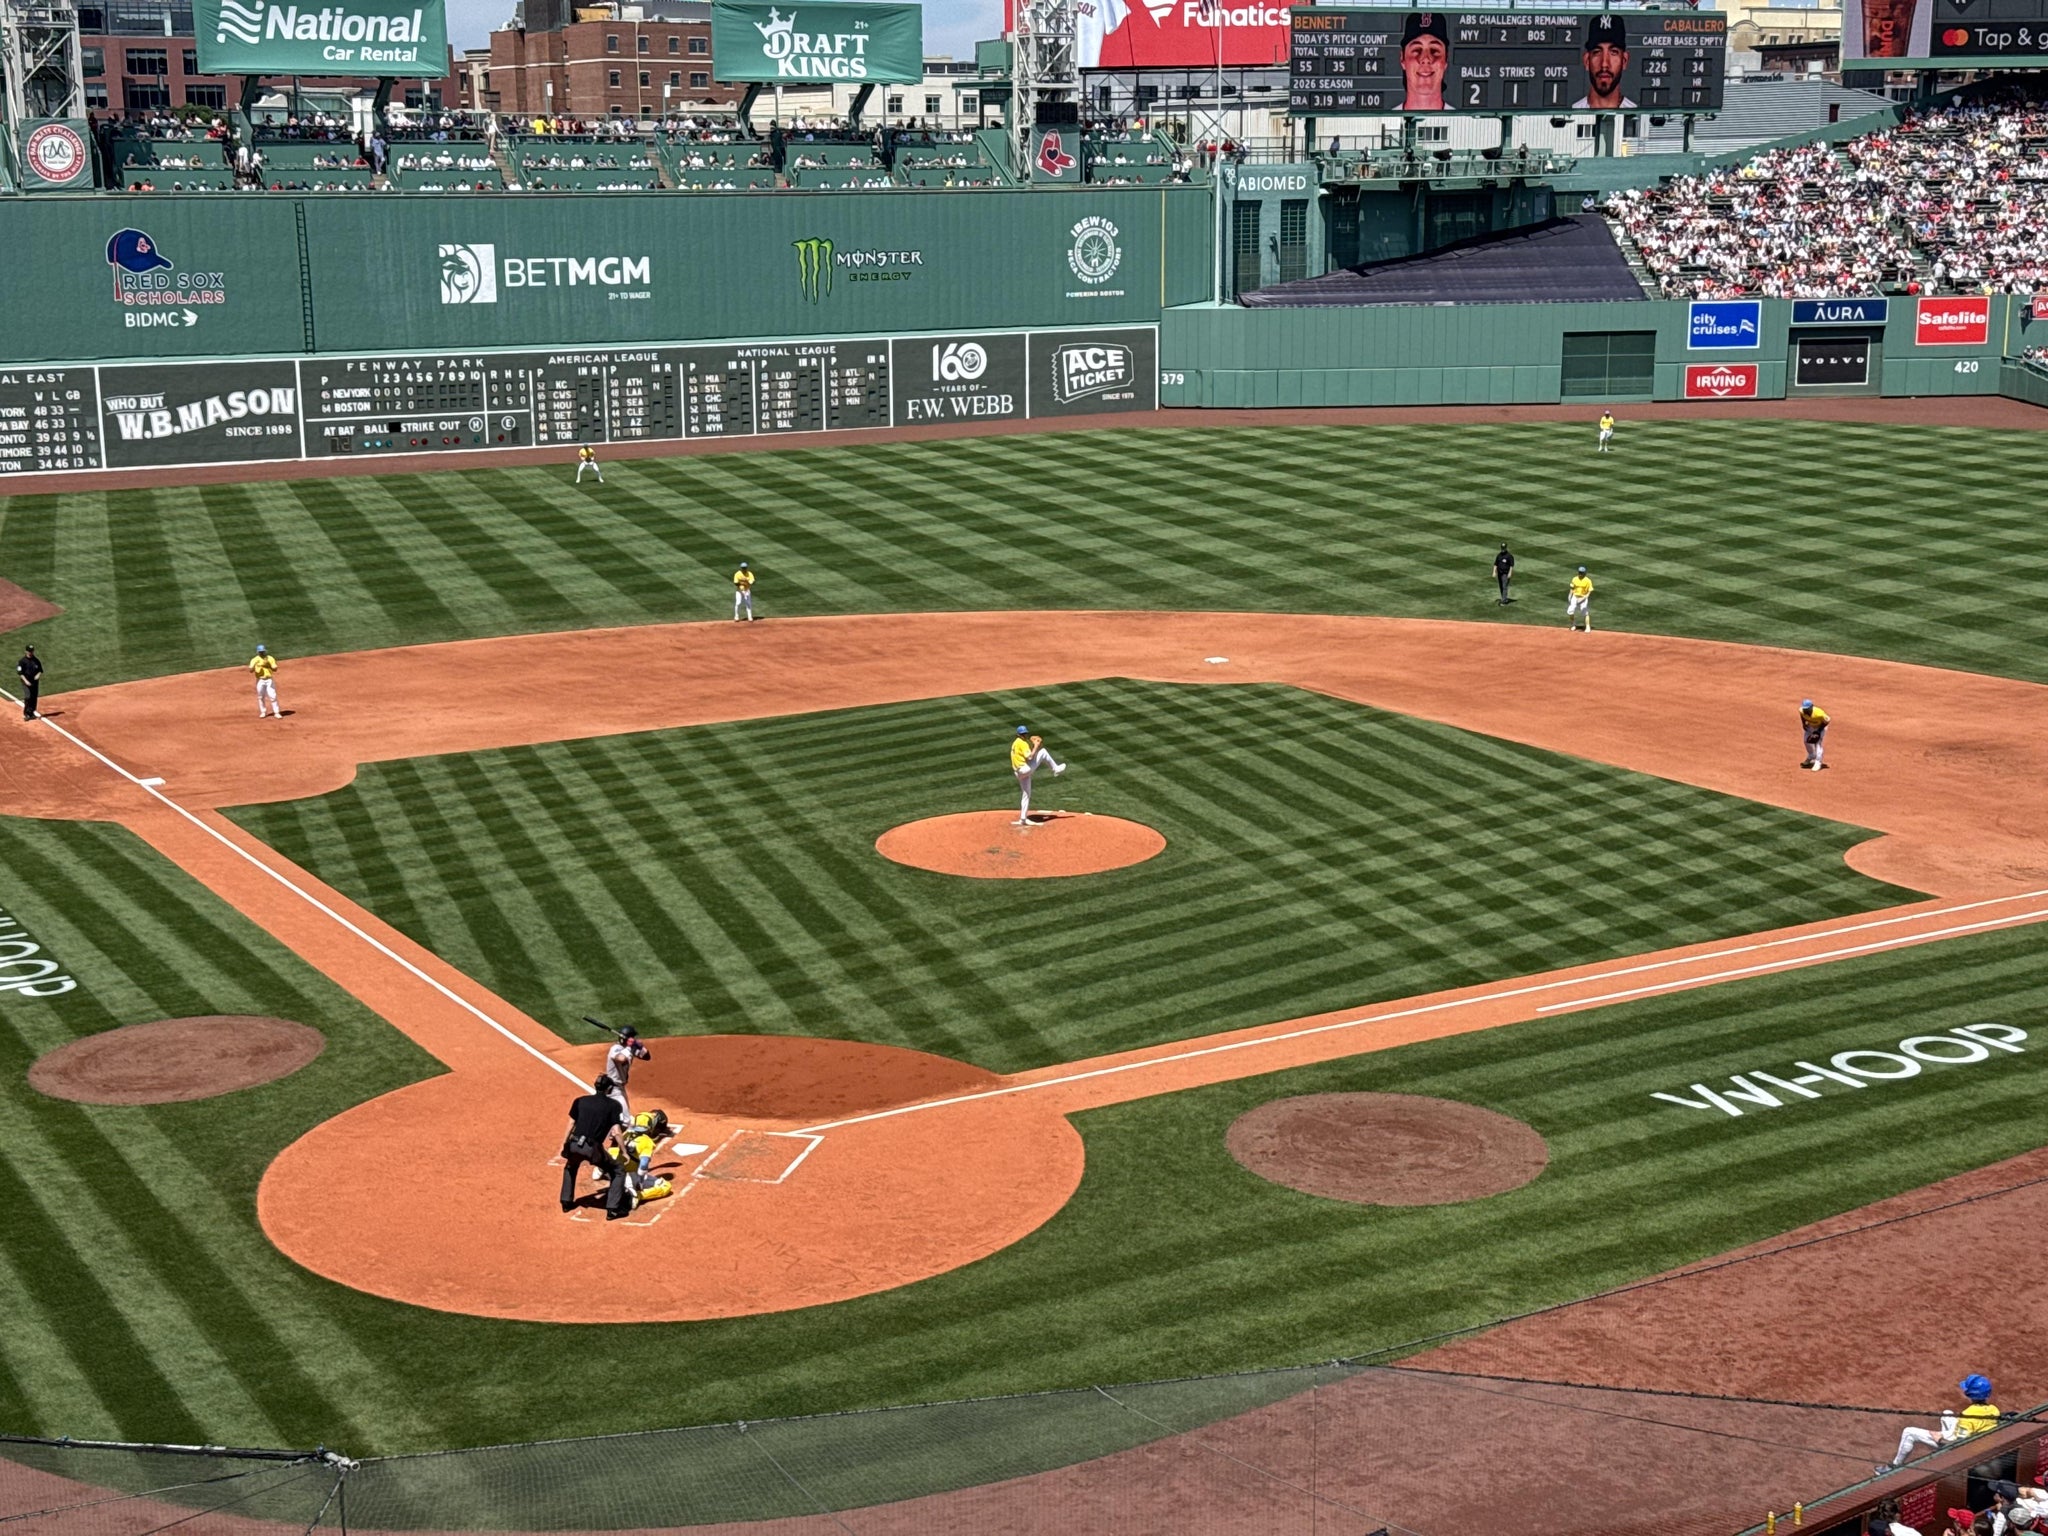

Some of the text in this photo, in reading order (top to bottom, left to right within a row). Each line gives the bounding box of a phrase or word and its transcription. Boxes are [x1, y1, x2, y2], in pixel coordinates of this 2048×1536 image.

[1077, 1, 1098, 18] SOX
[1183, 2, 1291, 28] Fanatics
[265, 5, 423, 43] National
[854, 20, 869, 30] 21+
[1294, 16, 1347, 29] BENNETT
[1459, 15, 1578, 26] ABS CHALLENGES REMAINING
[1663, 20, 1724, 32] CABALLERO
[1294, 34, 1388, 45] TODAY'S PITCH COUNT
[1460, 30, 1572, 42] NYY 2 BOS 2
[1642, 36, 1724, 46] CAREER BASES EMPTY
[1974, 28, 2012, 50] Tap
[2017, 27, 2032, 46] &
[763, 31, 870, 59] DRAFT
[323, 46, 418, 62] Car Rental
[1294, 47, 1379, 57] TOTAL STRIKES PCT
[1650, 49, 1664, 57] AVG
[778, 54, 868, 78] KINGS
[1299, 61, 1378, 72] 55 35 64
[1645, 62, 1705, 73] .226 34
[1461, 67, 1568, 78] BALLS STRIKES OUTS
[1293, 79, 1354, 88] 2026 SEASON
[1692, 78, 1702, 87] HR
[1470, 83, 1558, 104] 2 1 1
[1653, 91, 1702, 103] 1 17
[1291, 95, 1380, 106] ERA 3.19 WHIP 1.00
[1238, 176, 1307, 191] ABIOMED
[836, 248, 924, 268] MONSTER
[1067, 249, 1079, 274] NECA
[1077, 247, 1122, 284] CONTRACTORS
[504, 256, 651, 287] BETMGM
[849, 272, 912, 281] ENERGY
[123, 272, 225, 289] RED SOX
[124, 290, 226, 305] SCHOLARS
[629, 291, 651, 300] WAGER
[124, 312, 180, 328] BIDMC
[1693, 313, 1717, 326] city
[1919, 311, 1987, 326] Safelite
[1693, 324, 1737, 335] cruises
[737, 346, 836, 357] NATIONAL LEAGUE
[548, 353, 658, 364] AMERICAN LEAGUE
[932, 342, 988, 381] 160
[1069, 347, 1125, 374] ACE
[1802, 357, 1865, 365] VOLVO
[346, 359, 485, 371] FENWAY PARK
[1954, 361, 1979, 373] 420
[383, 370, 480, 383] 2 3 4 5 6 7 8 9 10
[775, 371, 792, 380] LAD
[845, 368, 860, 376] ATL
[26, 373, 65, 384] EAST
[1070, 368, 1125, 390] TICKET
[1161, 373, 1185, 385] 379
[1696, 374, 1746, 388] IRVING
[705, 384, 721, 393] STL
[845, 388, 861, 396] COL
[941, 384, 980, 393] YEARS OF
[34, 390, 81, 401] W L GB
[777, 391, 792, 399] CIN
[1101, 392, 1121, 401] SINCE
[105, 396, 164, 411] WHO BUT
[334, 402, 371, 413] BOSTON
[553, 401, 572, 409] HOU
[627, 398, 644, 406] SEA
[777, 400, 791, 409] PIT
[907, 394, 1014, 420] F.W. WEBB
[0, 405, 64, 418] YORK 48 33
[553, 411, 572, 419] DET
[627, 407, 644, 416] CLE
[11, 419, 65, 430] BAY 46 33
[401, 421, 460, 432] STRIKE OUT
[555, 421, 573, 430] TEX
[777, 420, 792, 428] BAL
[225, 424, 293, 437] SINCE 1898
[324, 424, 389, 436] AT BAT BALL
[556, 431, 573, 440] TOR
[36, 433, 50, 442] 39
[52, 432, 67, 442] 43
[72, 431, 80, 441] 9
[37, 446, 51, 456] 39
[54, 445, 67, 455] 44
[38, 458, 69, 469] 34 46
[1649, 1023, 2028, 1117] WHOOP
